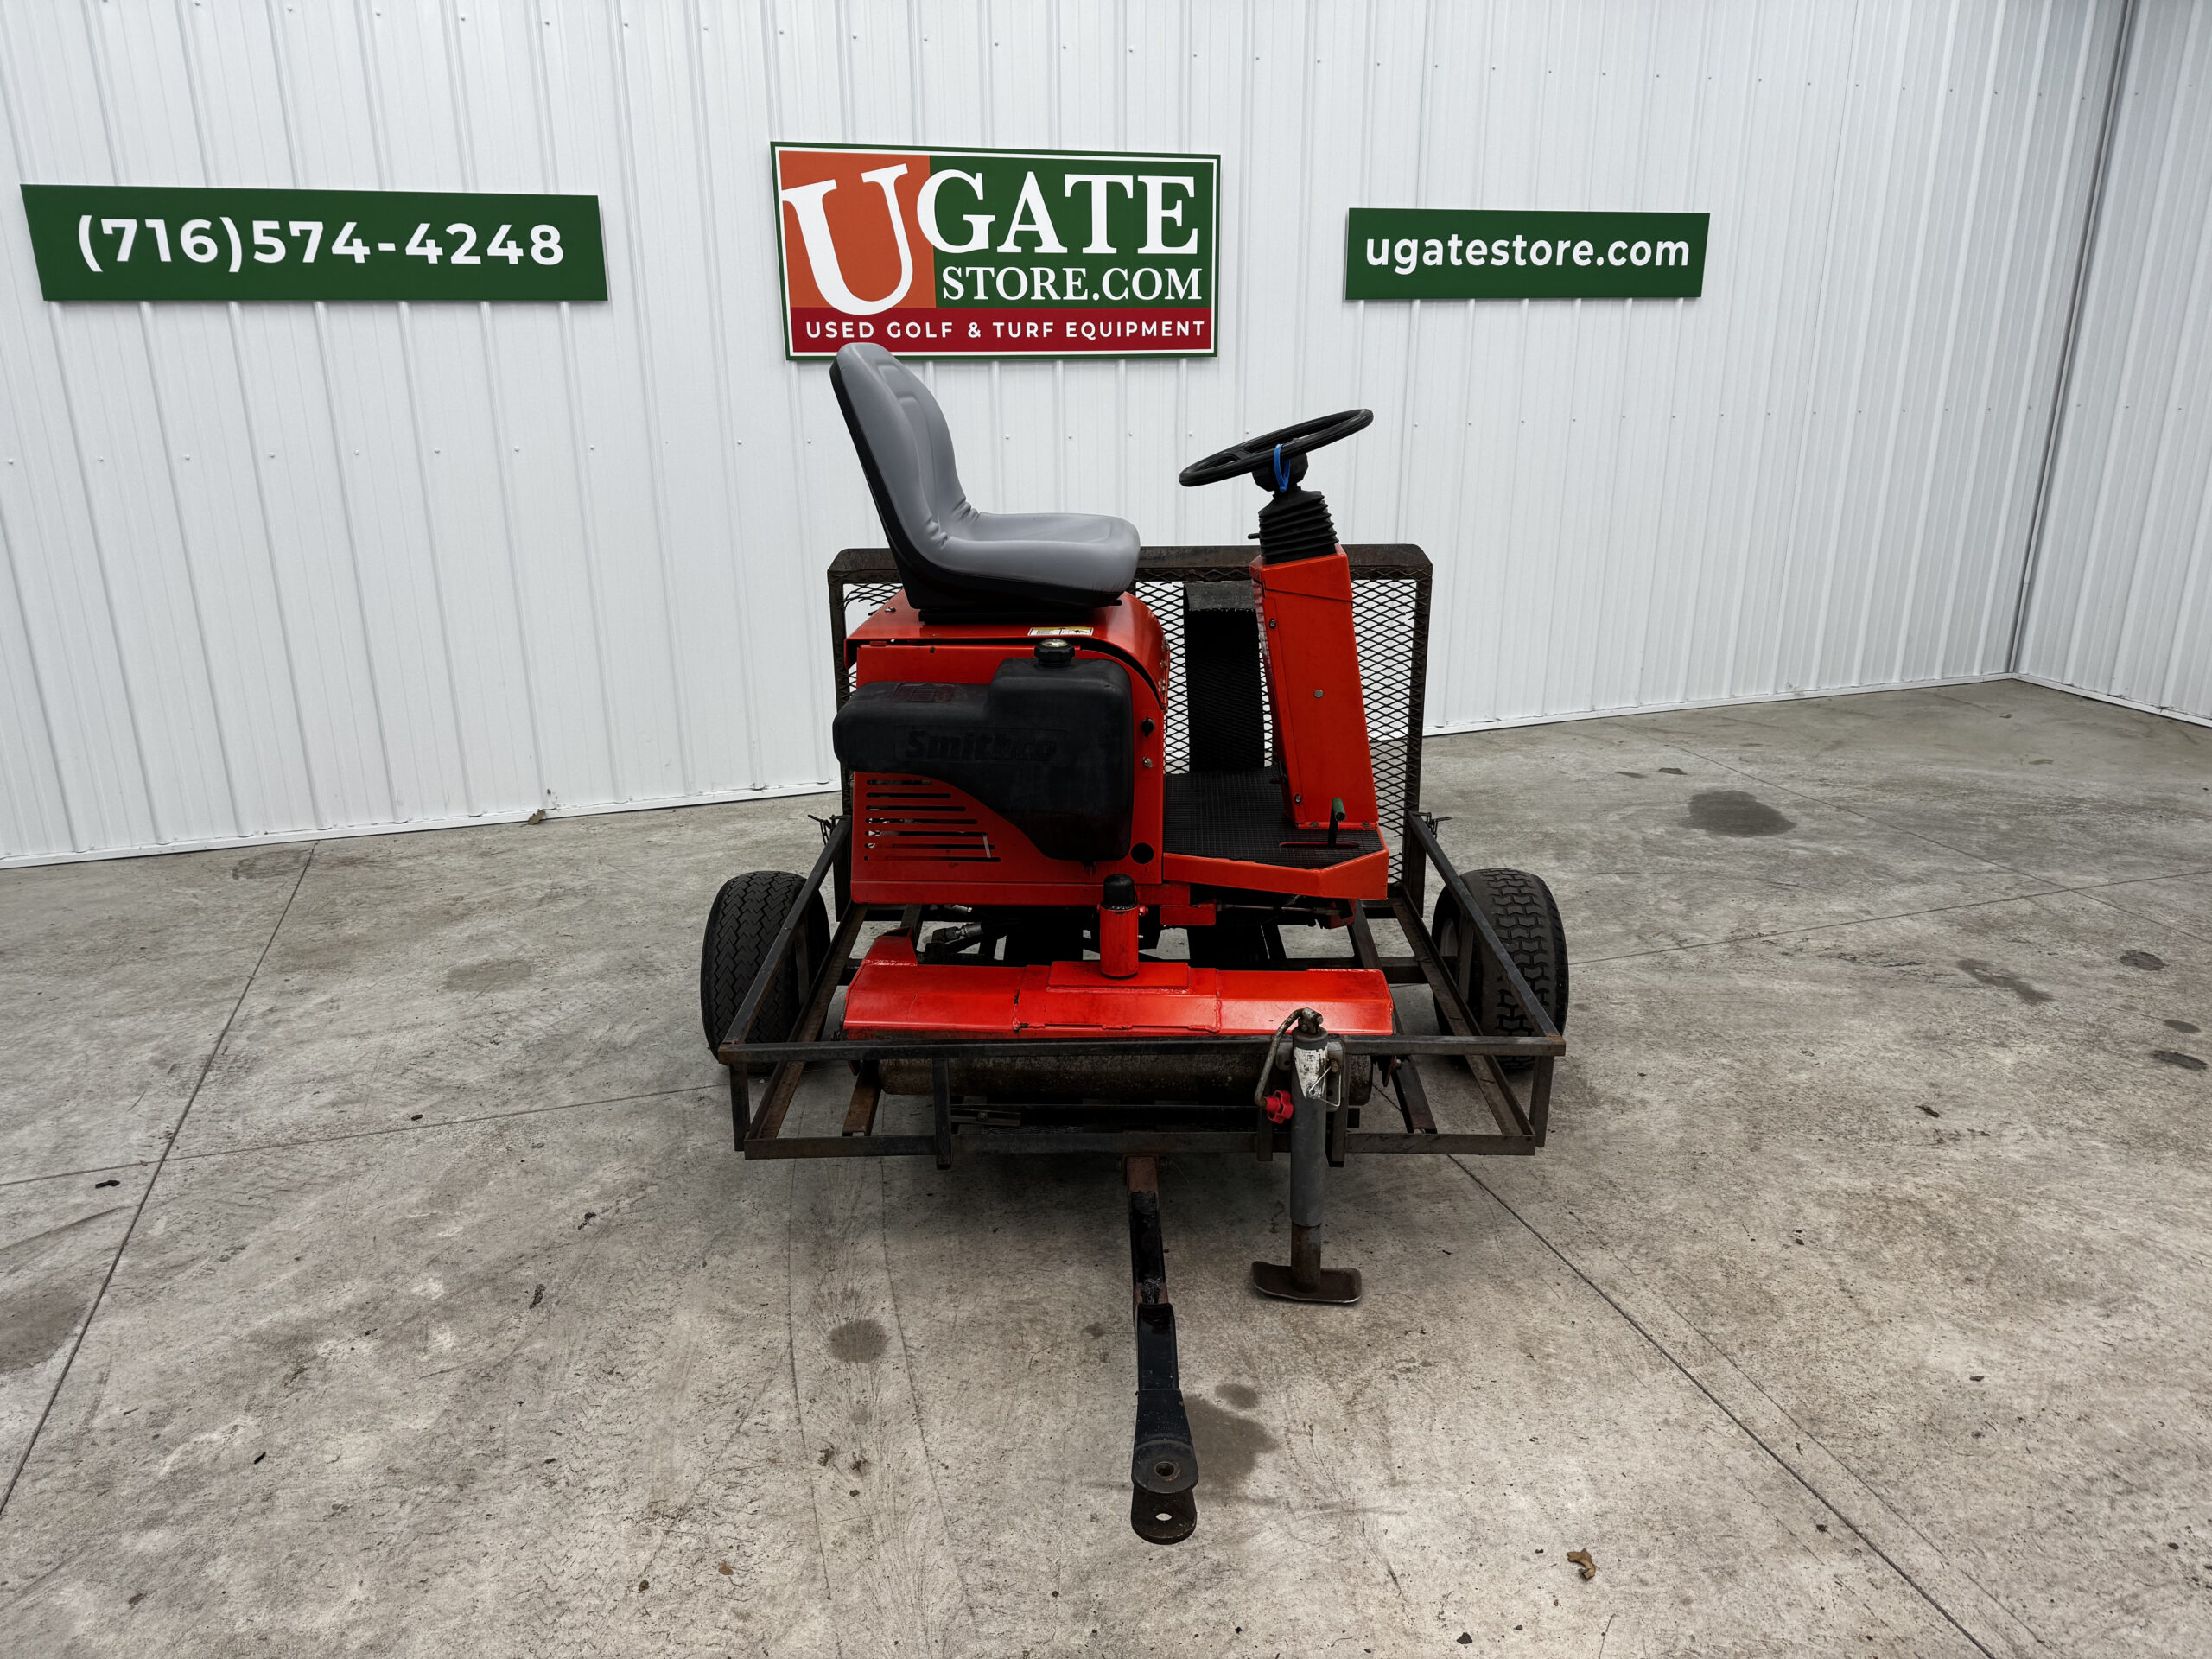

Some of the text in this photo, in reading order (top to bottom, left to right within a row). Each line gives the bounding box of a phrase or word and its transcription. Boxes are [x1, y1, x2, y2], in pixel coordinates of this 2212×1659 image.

[79, 215, 563, 272] (716)574-4248
[1367, 234, 1688, 275] ugatestore.com
[943, 266, 1202, 300] STORE.COM
[807, 321, 1204, 340] USED GOLF & TURF EQUIPMENT
[905, 728, 1057, 761] Smithco
